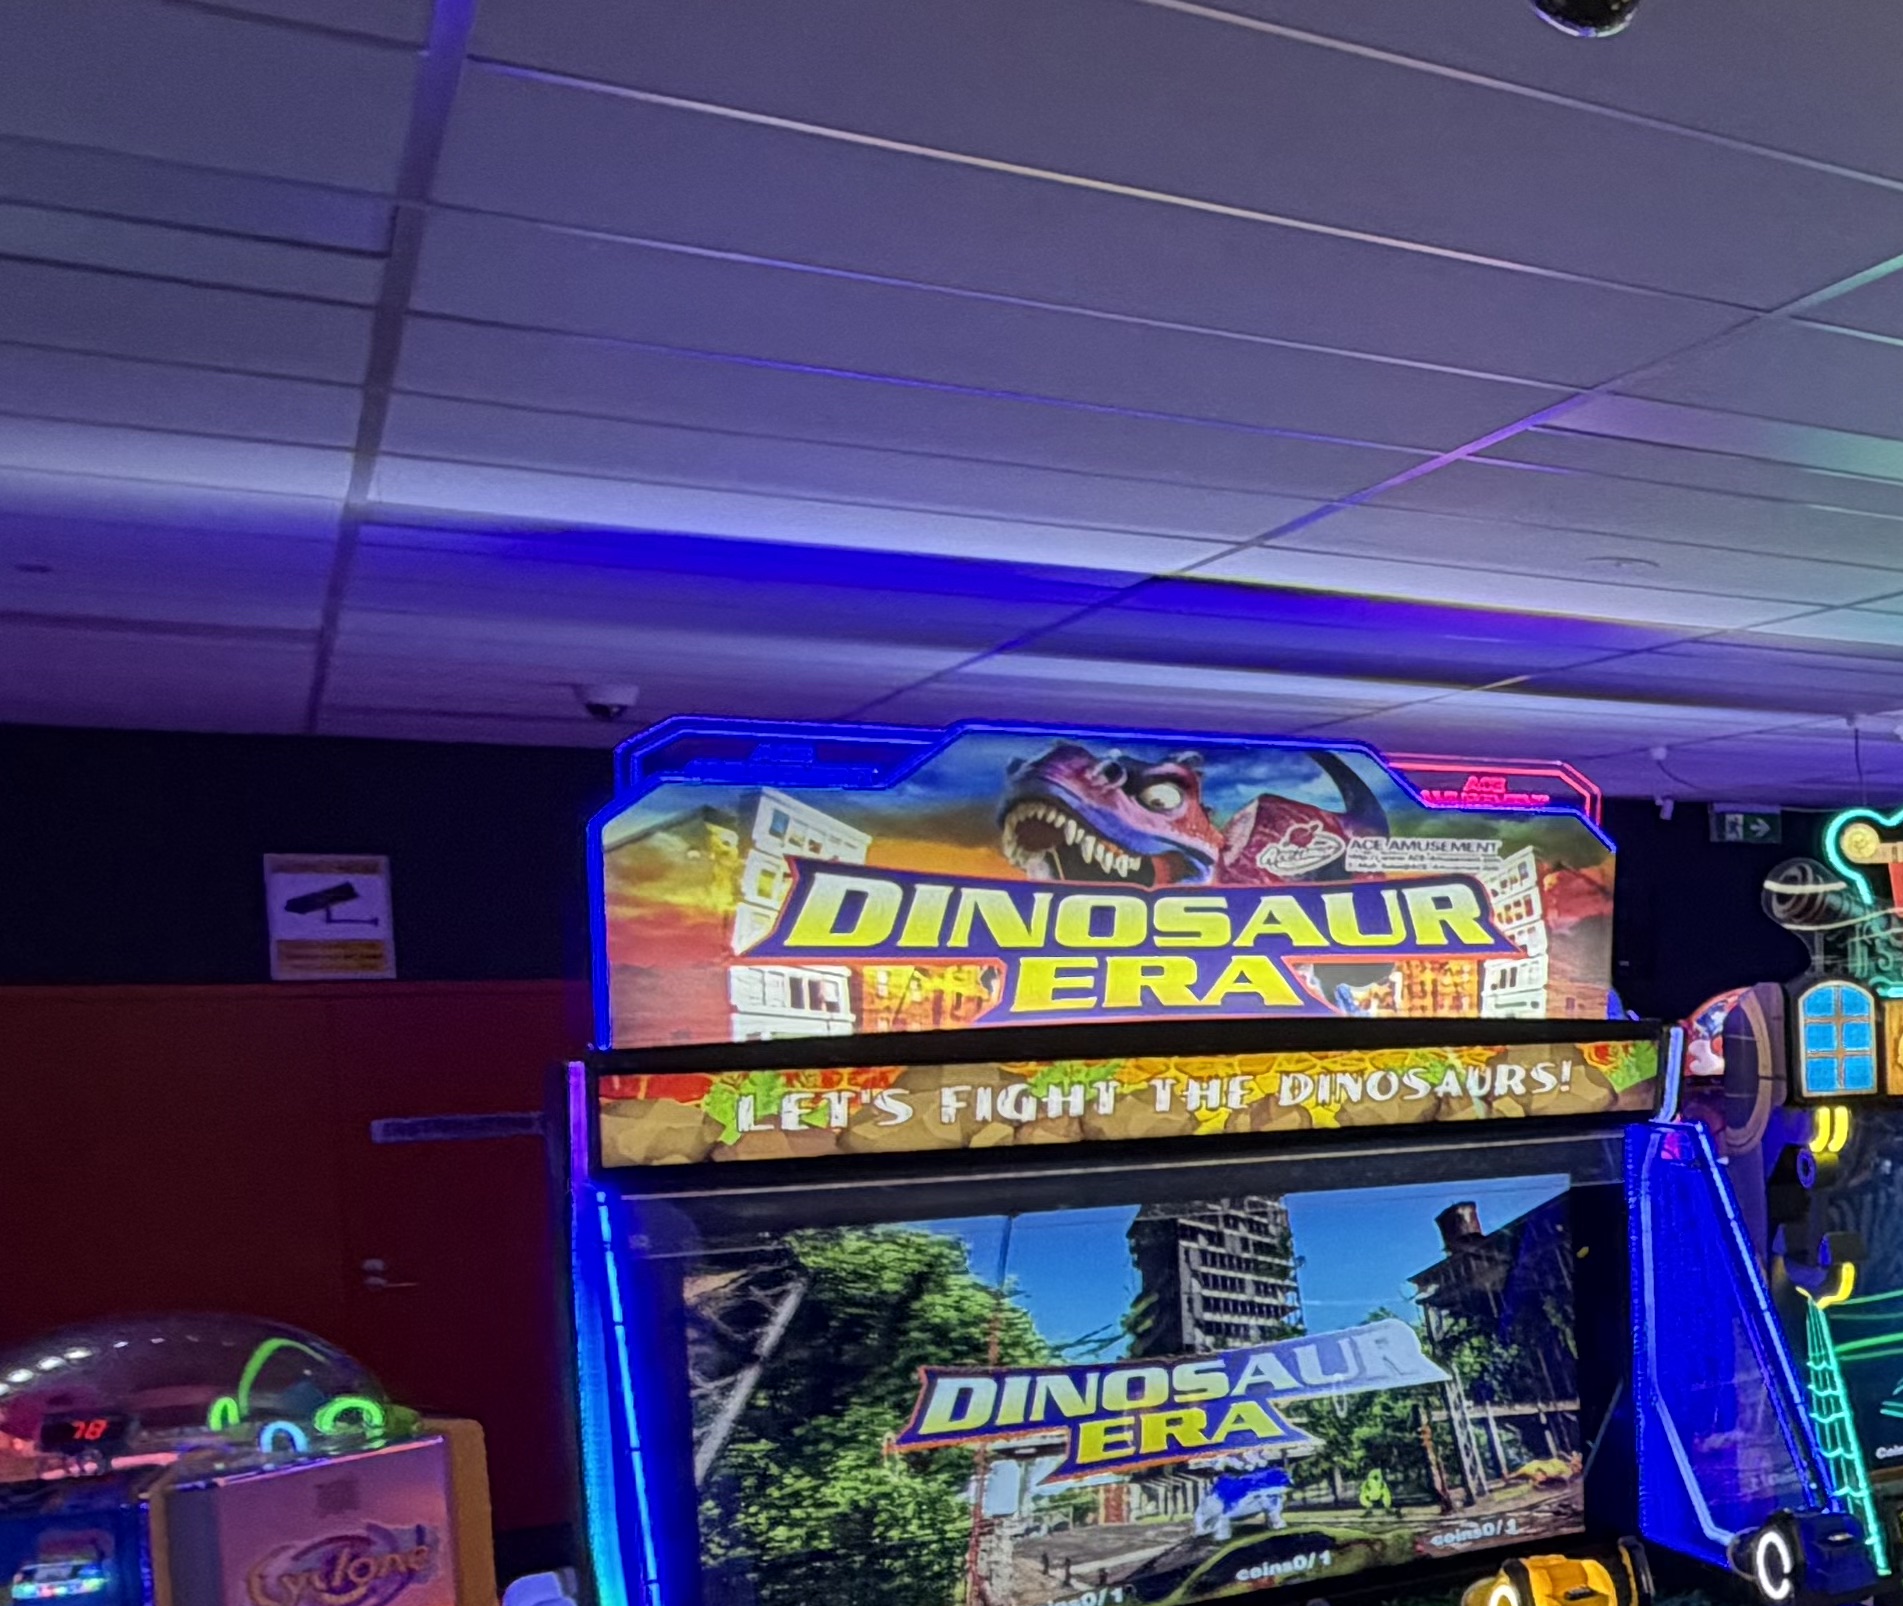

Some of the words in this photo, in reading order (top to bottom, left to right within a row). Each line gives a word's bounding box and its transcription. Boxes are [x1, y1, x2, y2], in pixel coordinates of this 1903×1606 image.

[1350, 839, 1383, 850] ACE
[1386, 840, 1498, 853] AMUSEMENT
[783, 873, 1497, 949] DINOSAUR
[1008, 955, 1305, 1013] ERA
[737, 1087, 914, 1133] LET'S
[940, 1080, 1120, 1124] FIGHT
[1149, 1074, 1256, 1112] THE
[1277, 1059, 1573, 1108] DINOSAURS!
[917, 1325, 1419, 1435] DINOSAUR
[1076, 1400, 1283, 1464] ERA
